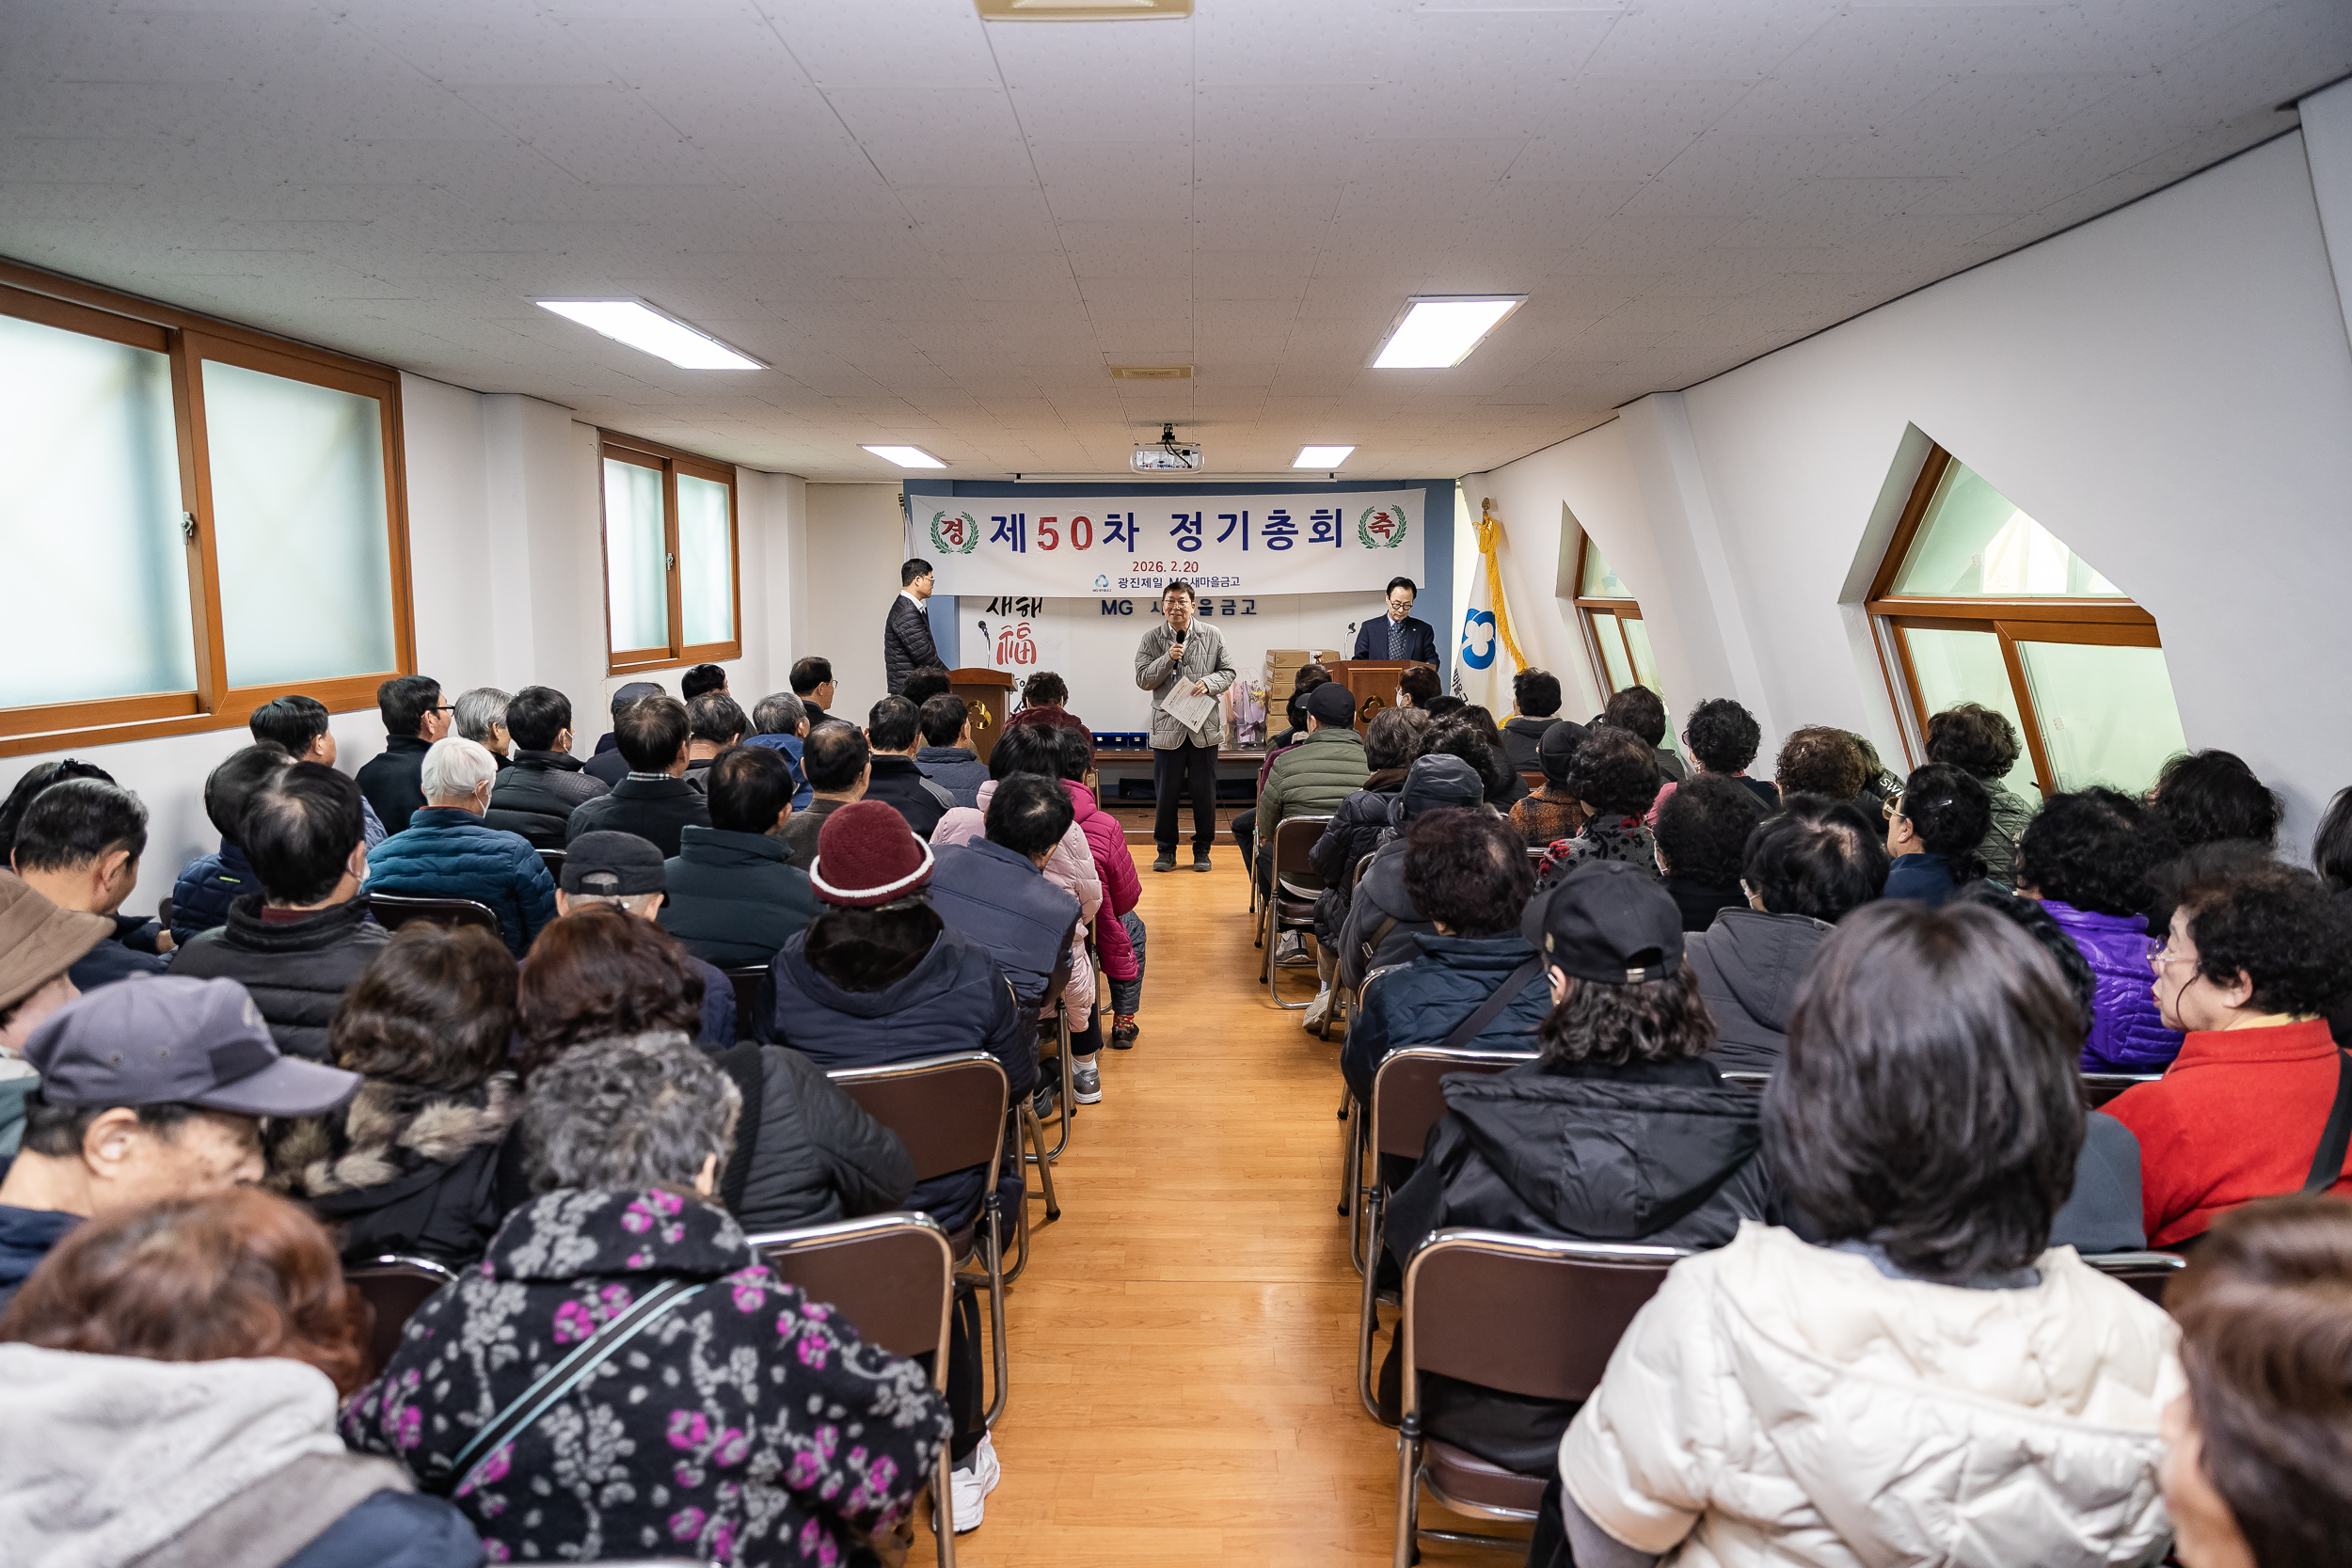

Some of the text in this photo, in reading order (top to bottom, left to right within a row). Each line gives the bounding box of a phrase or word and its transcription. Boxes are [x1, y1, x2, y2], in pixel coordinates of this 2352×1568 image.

[941, 517, 963, 545] 경
[989, 508, 1343, 553] 제50차 정기총회
[1367, 512, 1395, 539] 축
[1118, 577, 1163, 589] 광진제일
[985, 595, 1043, 618] 새해
[1101, 599, 1134, 616] MG
[996, 622, 1037, 666] 福
